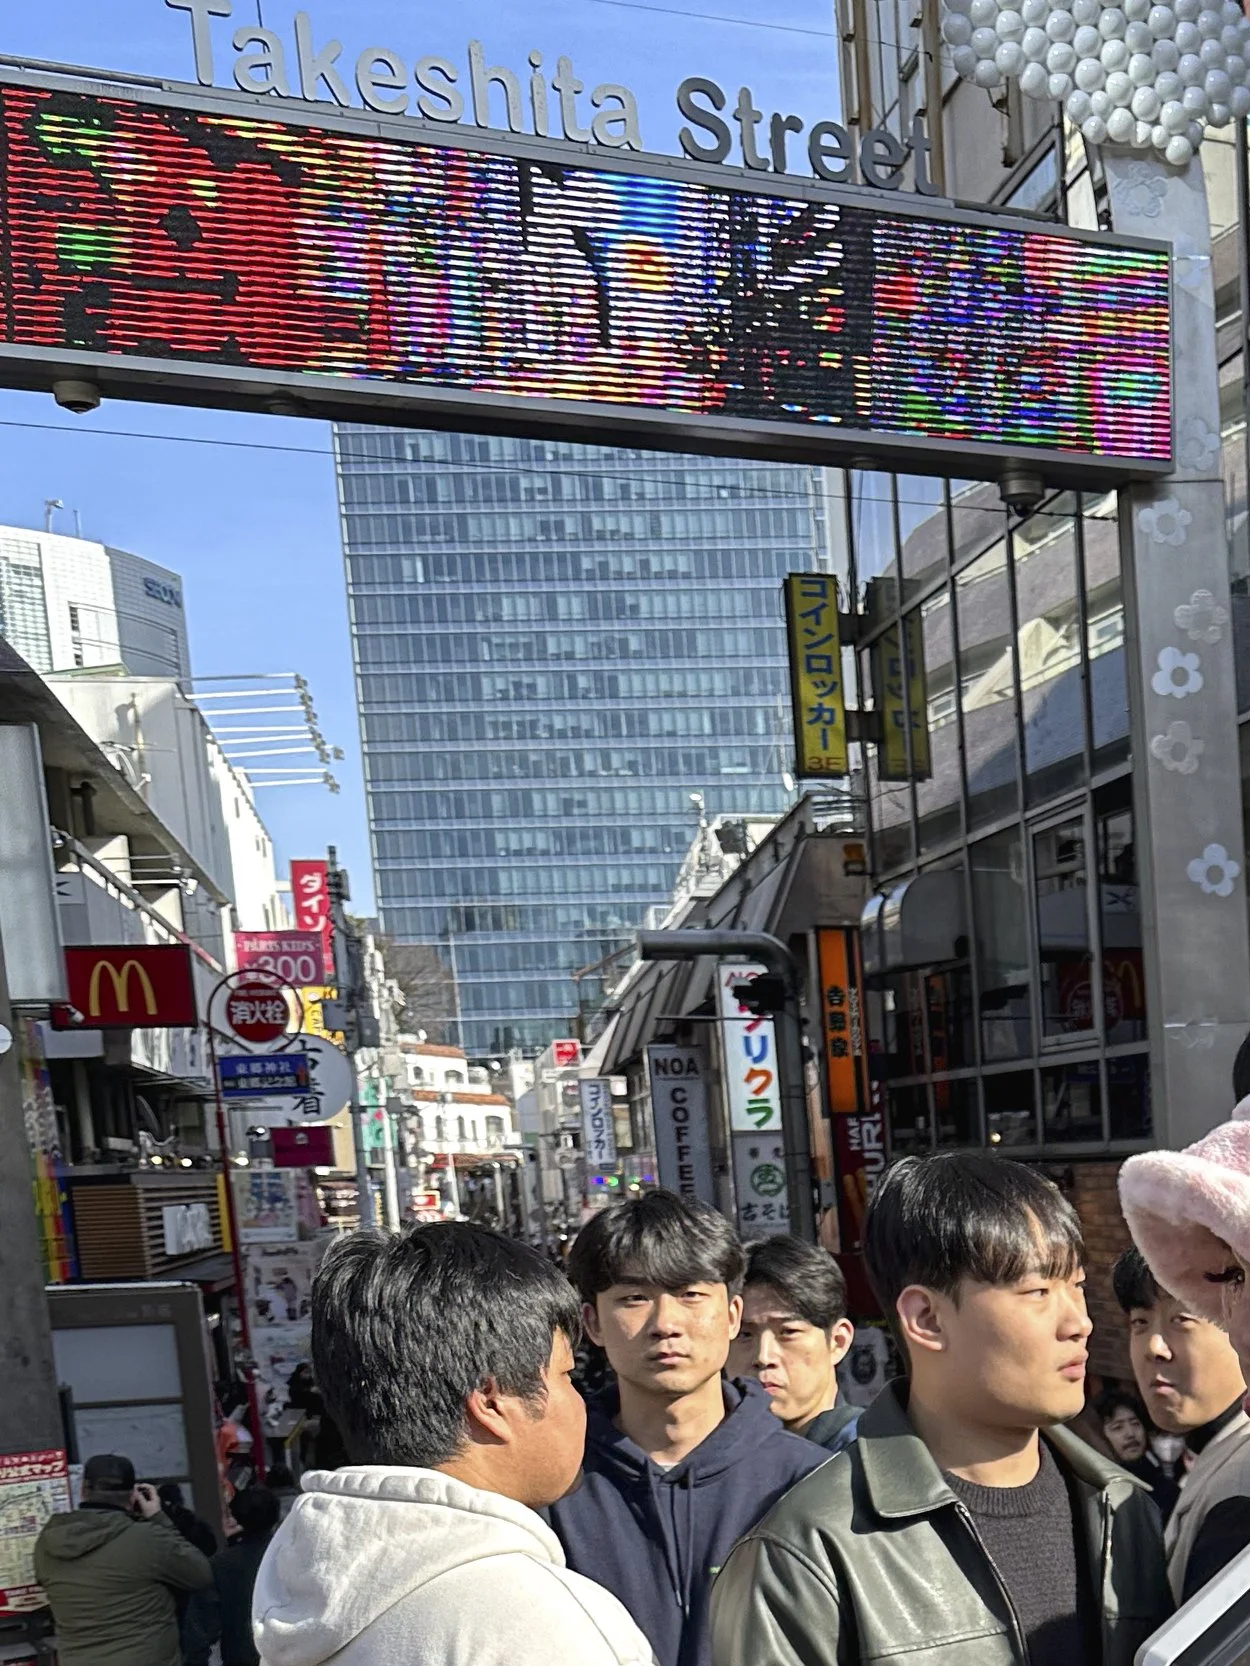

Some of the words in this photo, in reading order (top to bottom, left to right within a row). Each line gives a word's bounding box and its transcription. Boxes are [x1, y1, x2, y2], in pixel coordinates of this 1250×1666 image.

[166, 0, 642, 151] Takeshita
[677, 76, 939, 196] Street
[799, 579, 839, 751] コインロッカー
[231, 1000, 285, 1025] 消火栓
[654, 1058, 699, 1076] NOA
[670, 1087, 695, 1196] COFFEE
